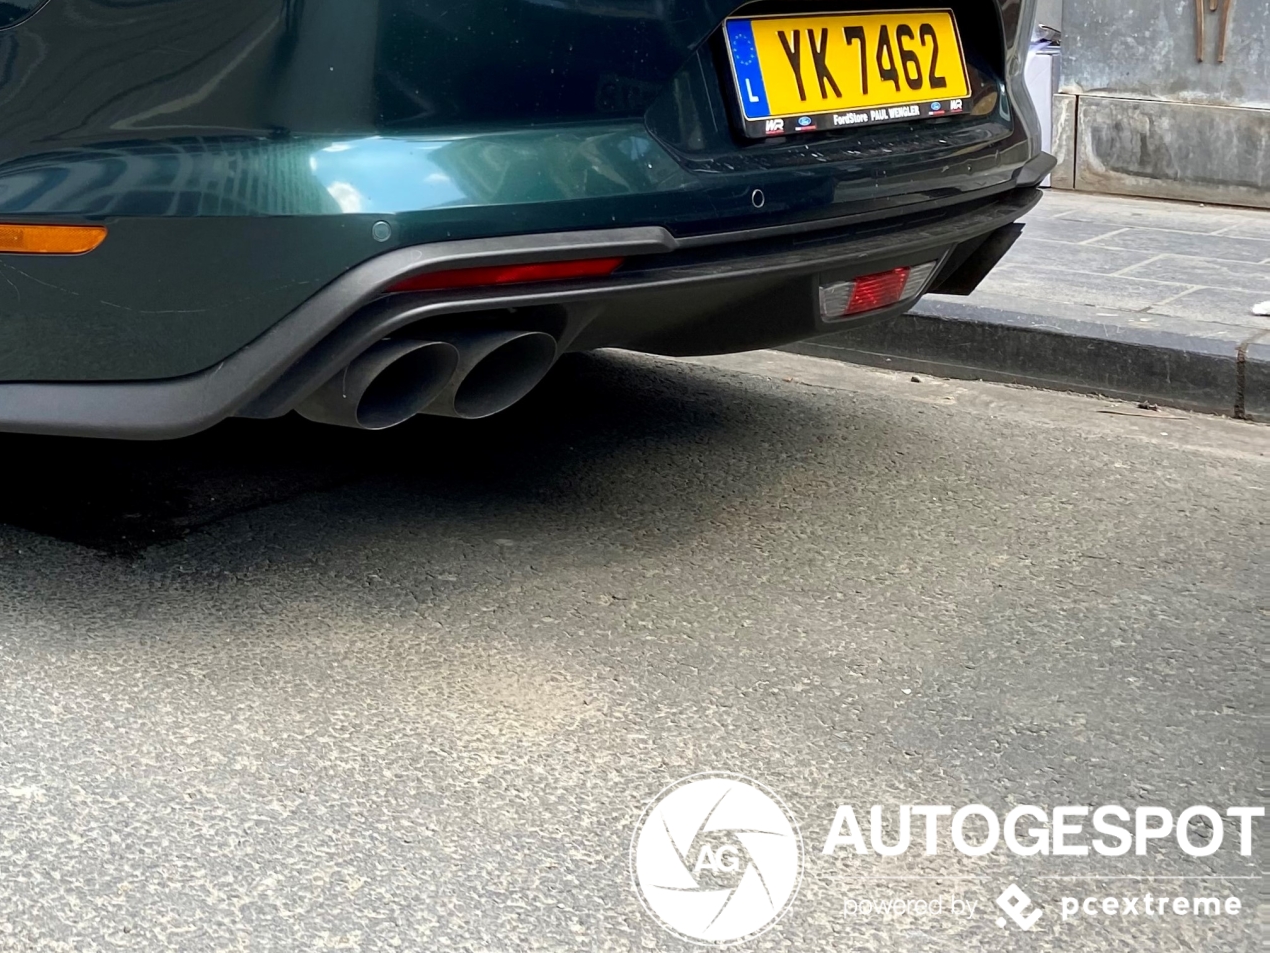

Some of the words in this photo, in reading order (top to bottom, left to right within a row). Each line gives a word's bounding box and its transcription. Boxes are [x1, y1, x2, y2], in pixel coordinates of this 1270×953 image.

[777, 27, 842, 102] YK
[843, 23, 947, 96] 7462
[745, 78, 759, 103] L
[833, 112, 868, 126] FordStore
[870, 109, 889, 121] PAUL
